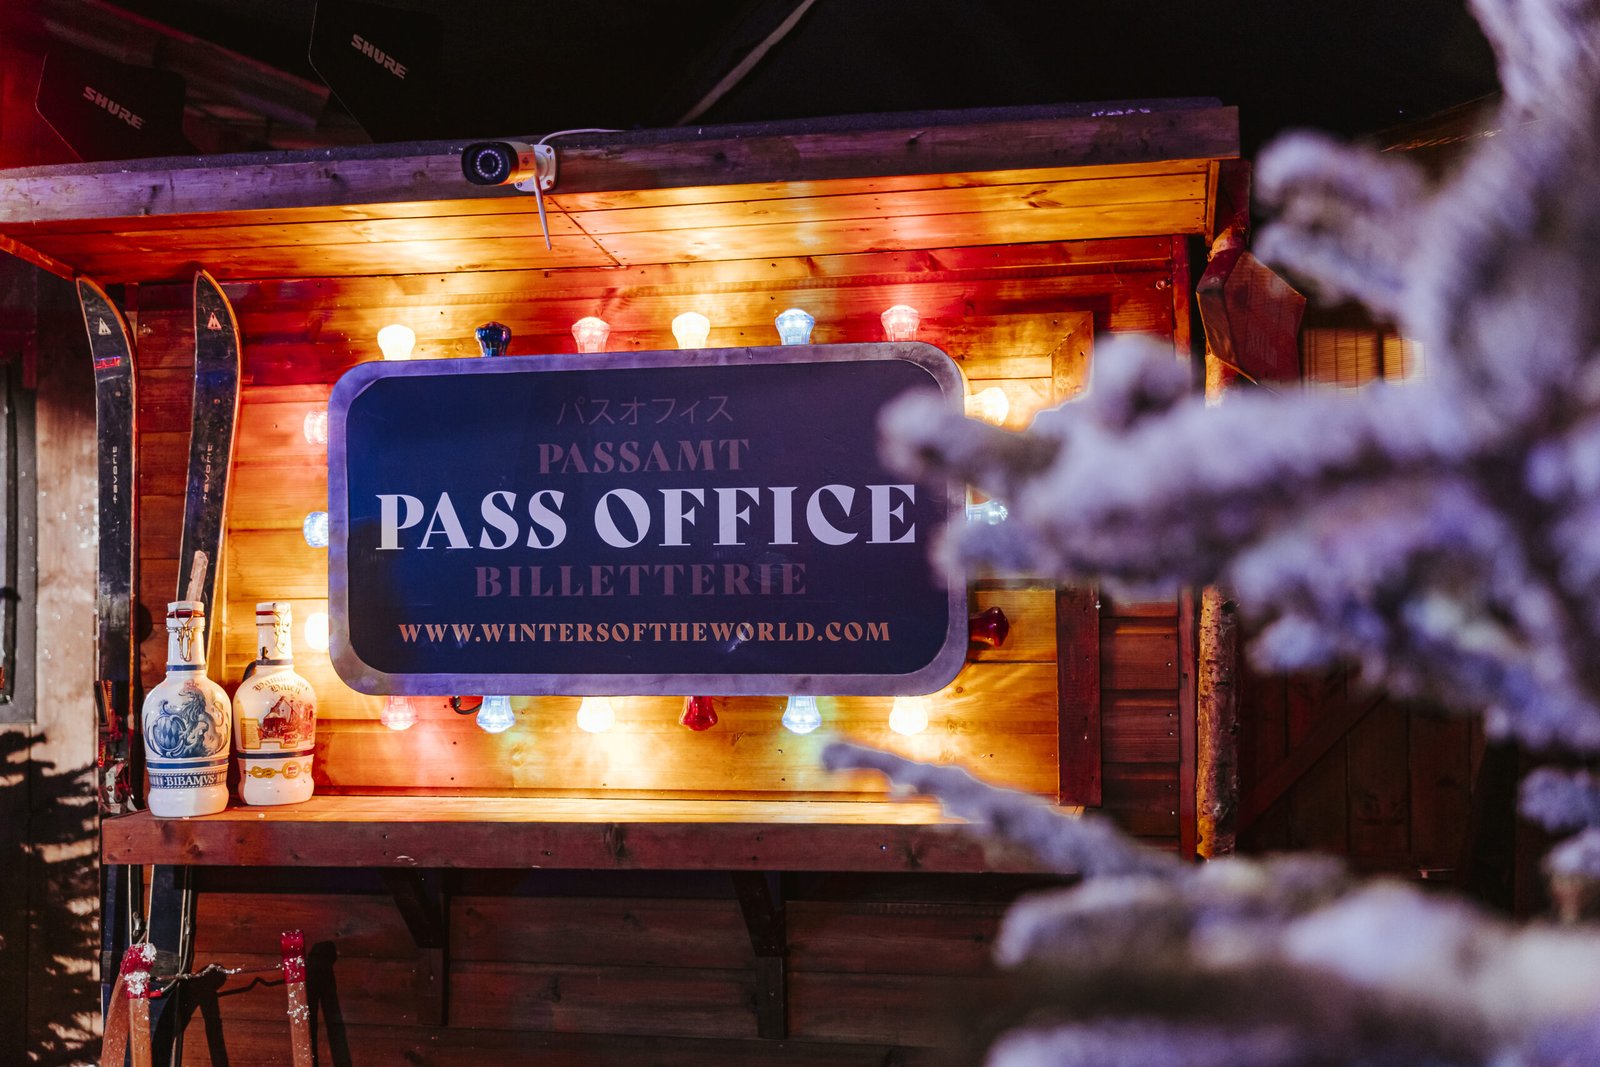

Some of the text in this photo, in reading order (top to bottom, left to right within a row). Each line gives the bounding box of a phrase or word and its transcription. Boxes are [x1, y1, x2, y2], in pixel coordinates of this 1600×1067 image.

[351, 34, 407, 80] SHURE
[83, 86, 144, 130] SHURE
[556, 396, 733, 425] パスオフィス
[538, 438, 749, 474] PASSAMT
[375, 484, 915, 550] PASS OFFICE
[475, 563, 806, 597] BILLETTERIE
[398, 621, 891, 643] WWW.WINTERSOFTHEWORLD.COM
